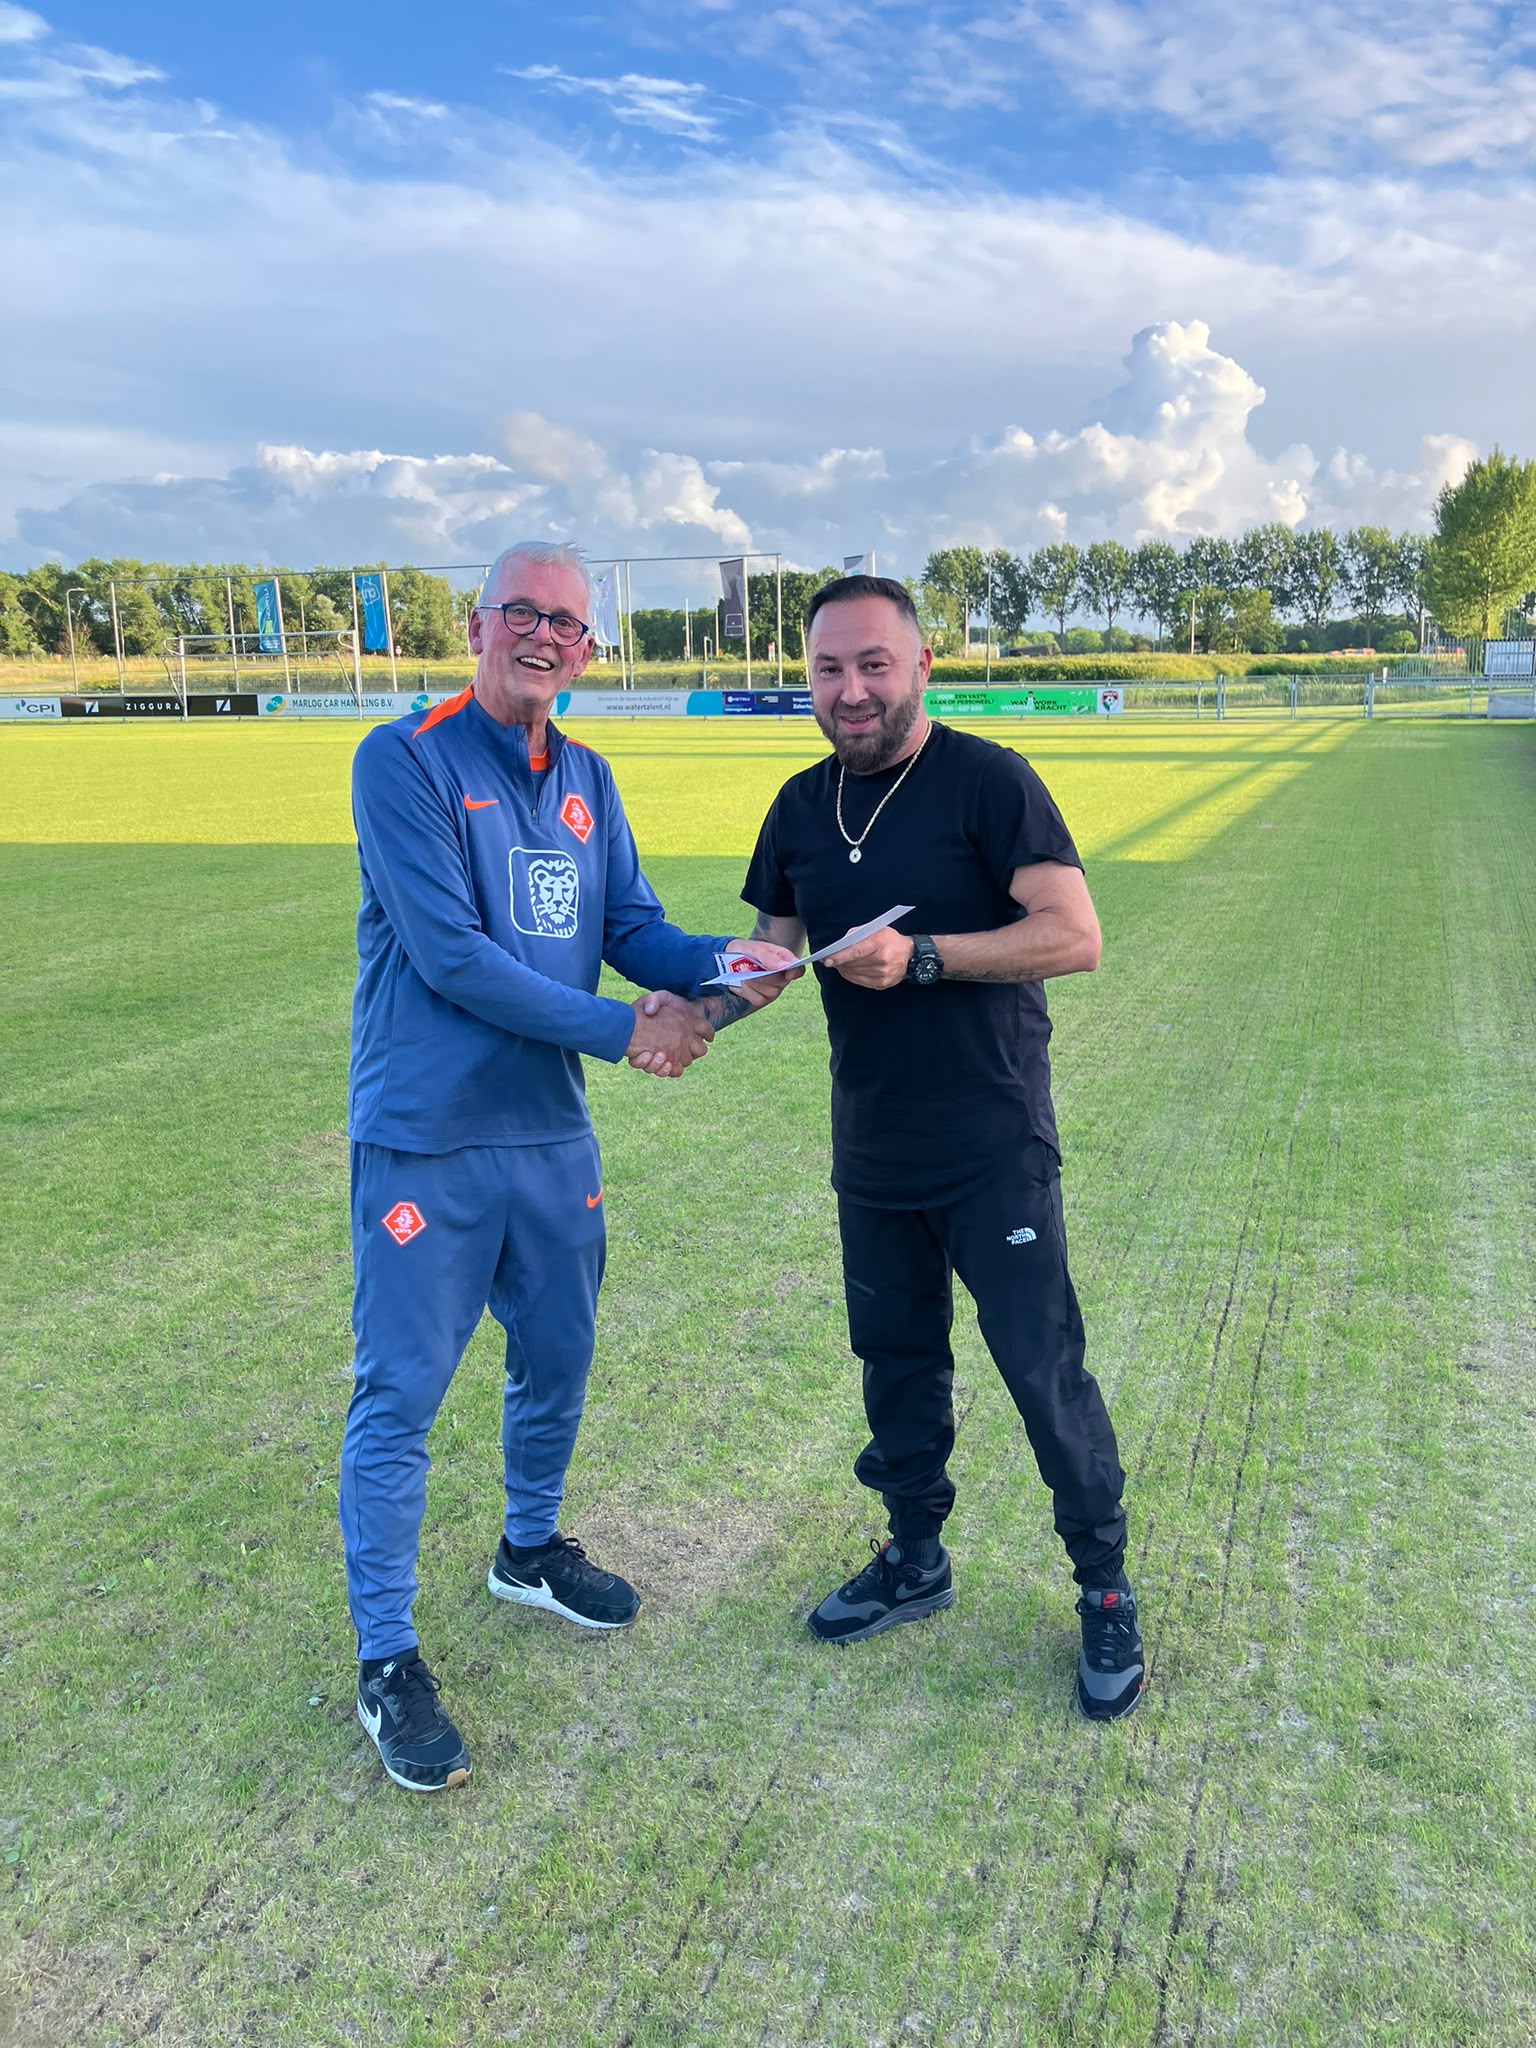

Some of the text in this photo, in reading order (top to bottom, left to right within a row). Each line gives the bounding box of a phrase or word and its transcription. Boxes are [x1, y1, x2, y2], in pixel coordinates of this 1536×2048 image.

[126, 702, 181, 711] ZIGGURA
[292, 699, 322, 708] MARLOG
[324, 699, 339, 708] CAR
[341, 698, 379, 708] HANLING
[606, 703, 671, 711] www.watertalent.nl
[27, 704, 55, 713] CPI
[1006, 1233, 1026, 1241] NORTH
